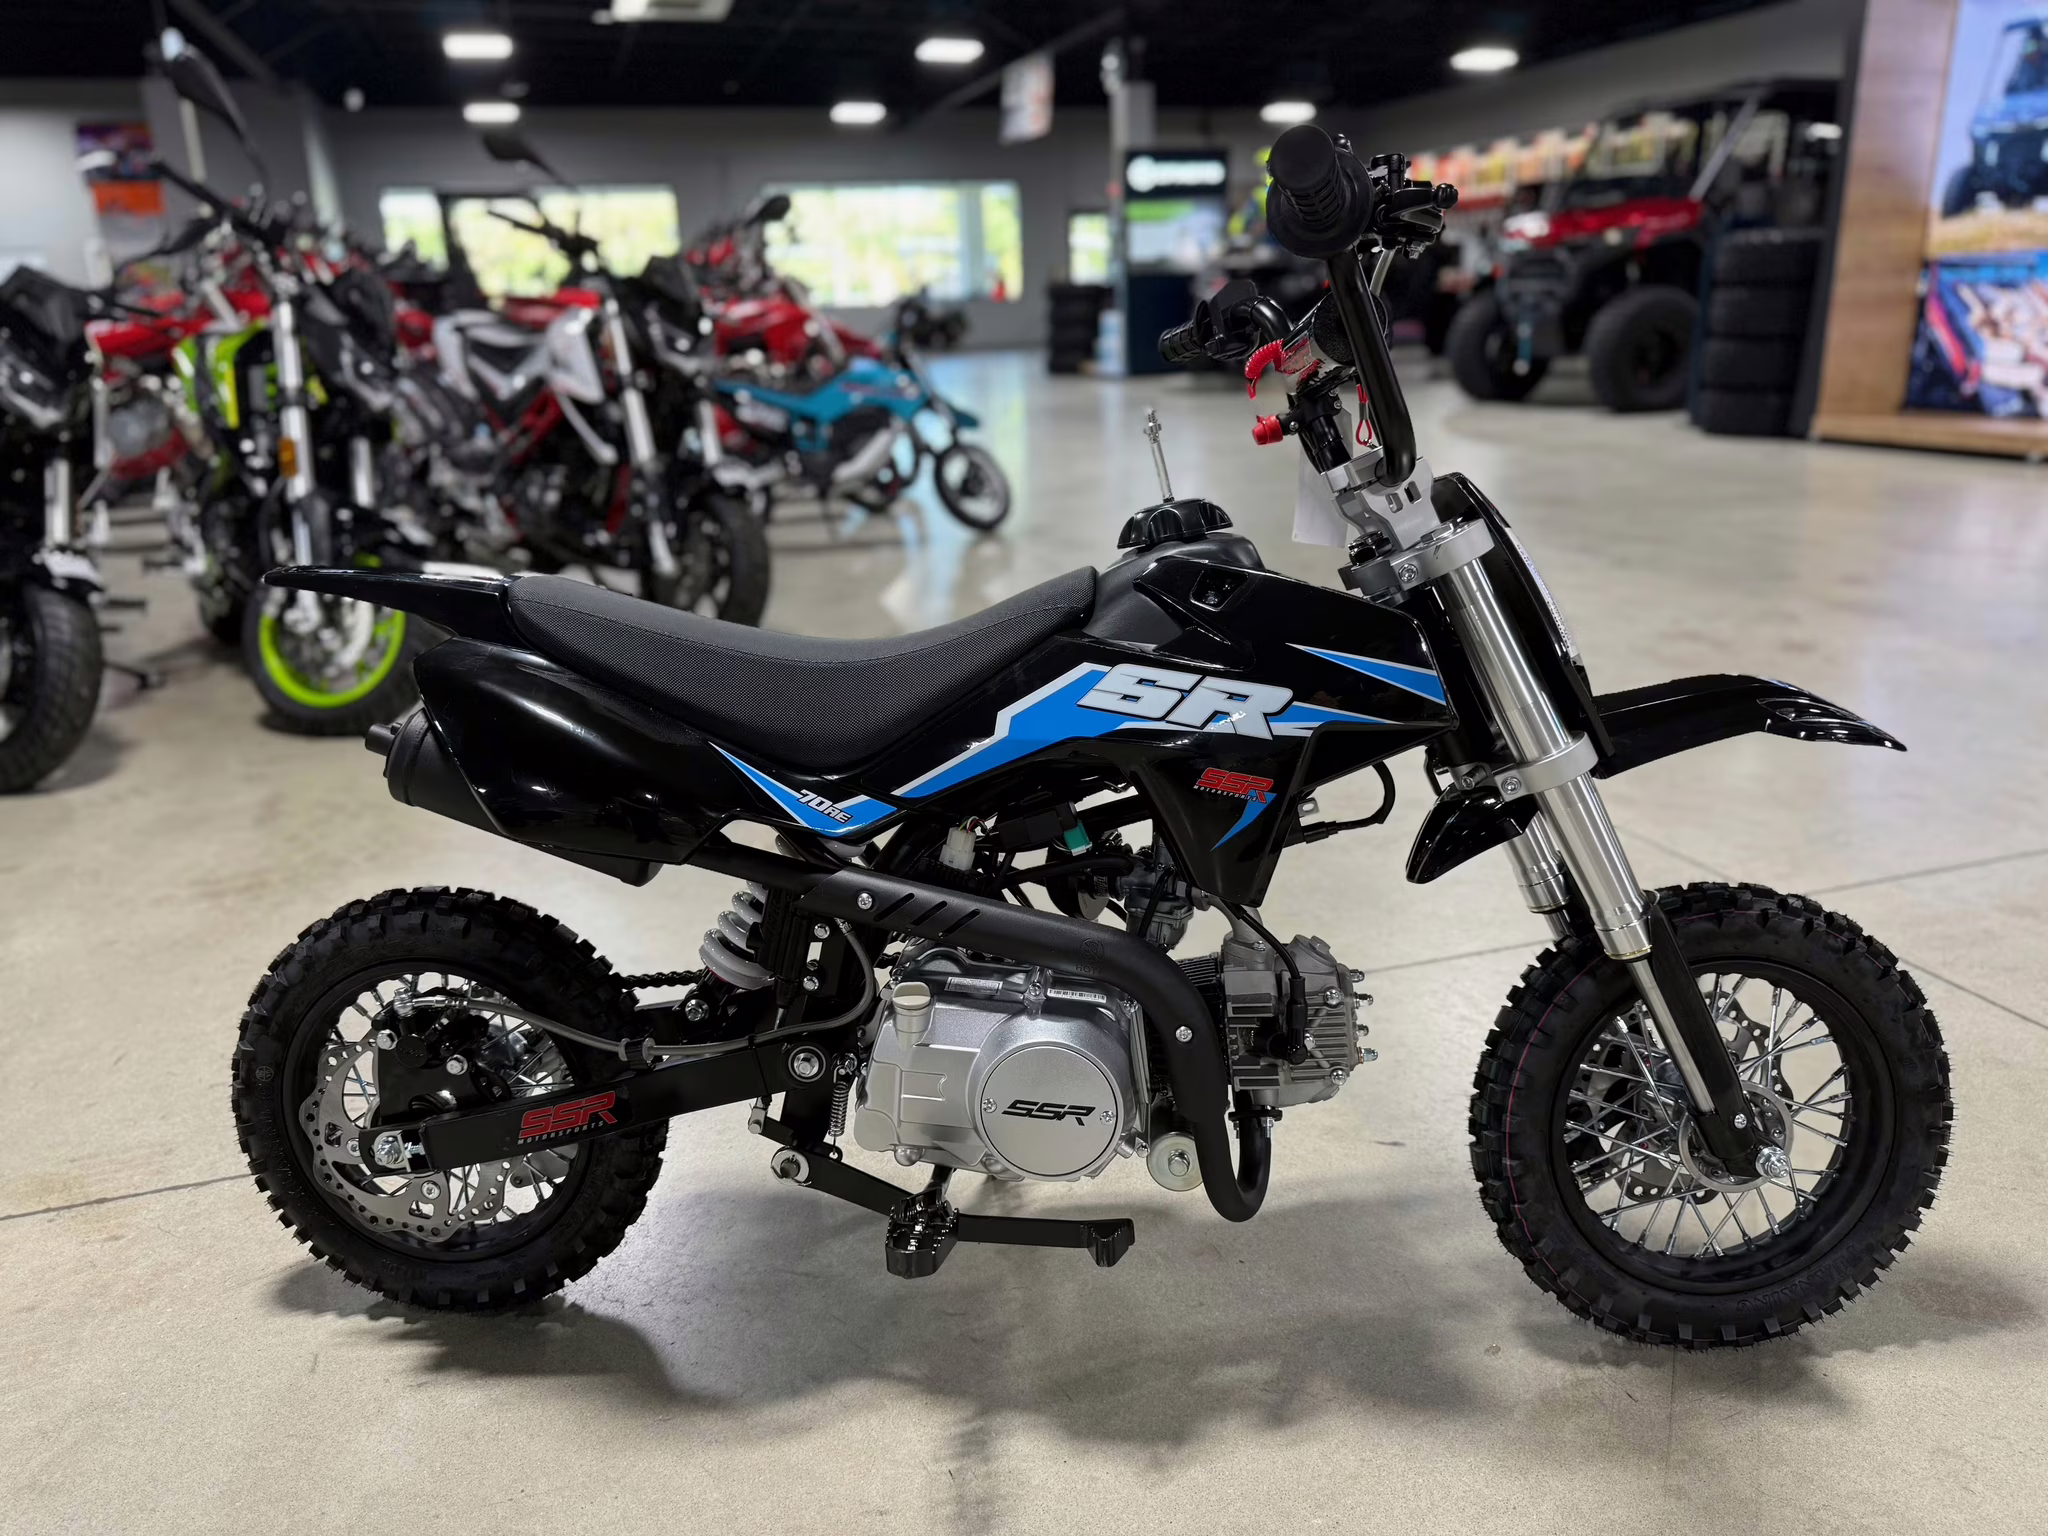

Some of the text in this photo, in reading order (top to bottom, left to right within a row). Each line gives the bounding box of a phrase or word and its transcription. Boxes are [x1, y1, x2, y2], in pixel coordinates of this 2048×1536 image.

[1076, 663, 1293, 740] SR
[1193, 784, 1258, 802] MOTORSPORTS
[1195, 767, 1274, 804] SSR
[519, 1090, 618, 1138] SSR
[1001, 1099, 1096, 1126] SSR
[517, 1120, 604, 1145] MOTORSPORTS
